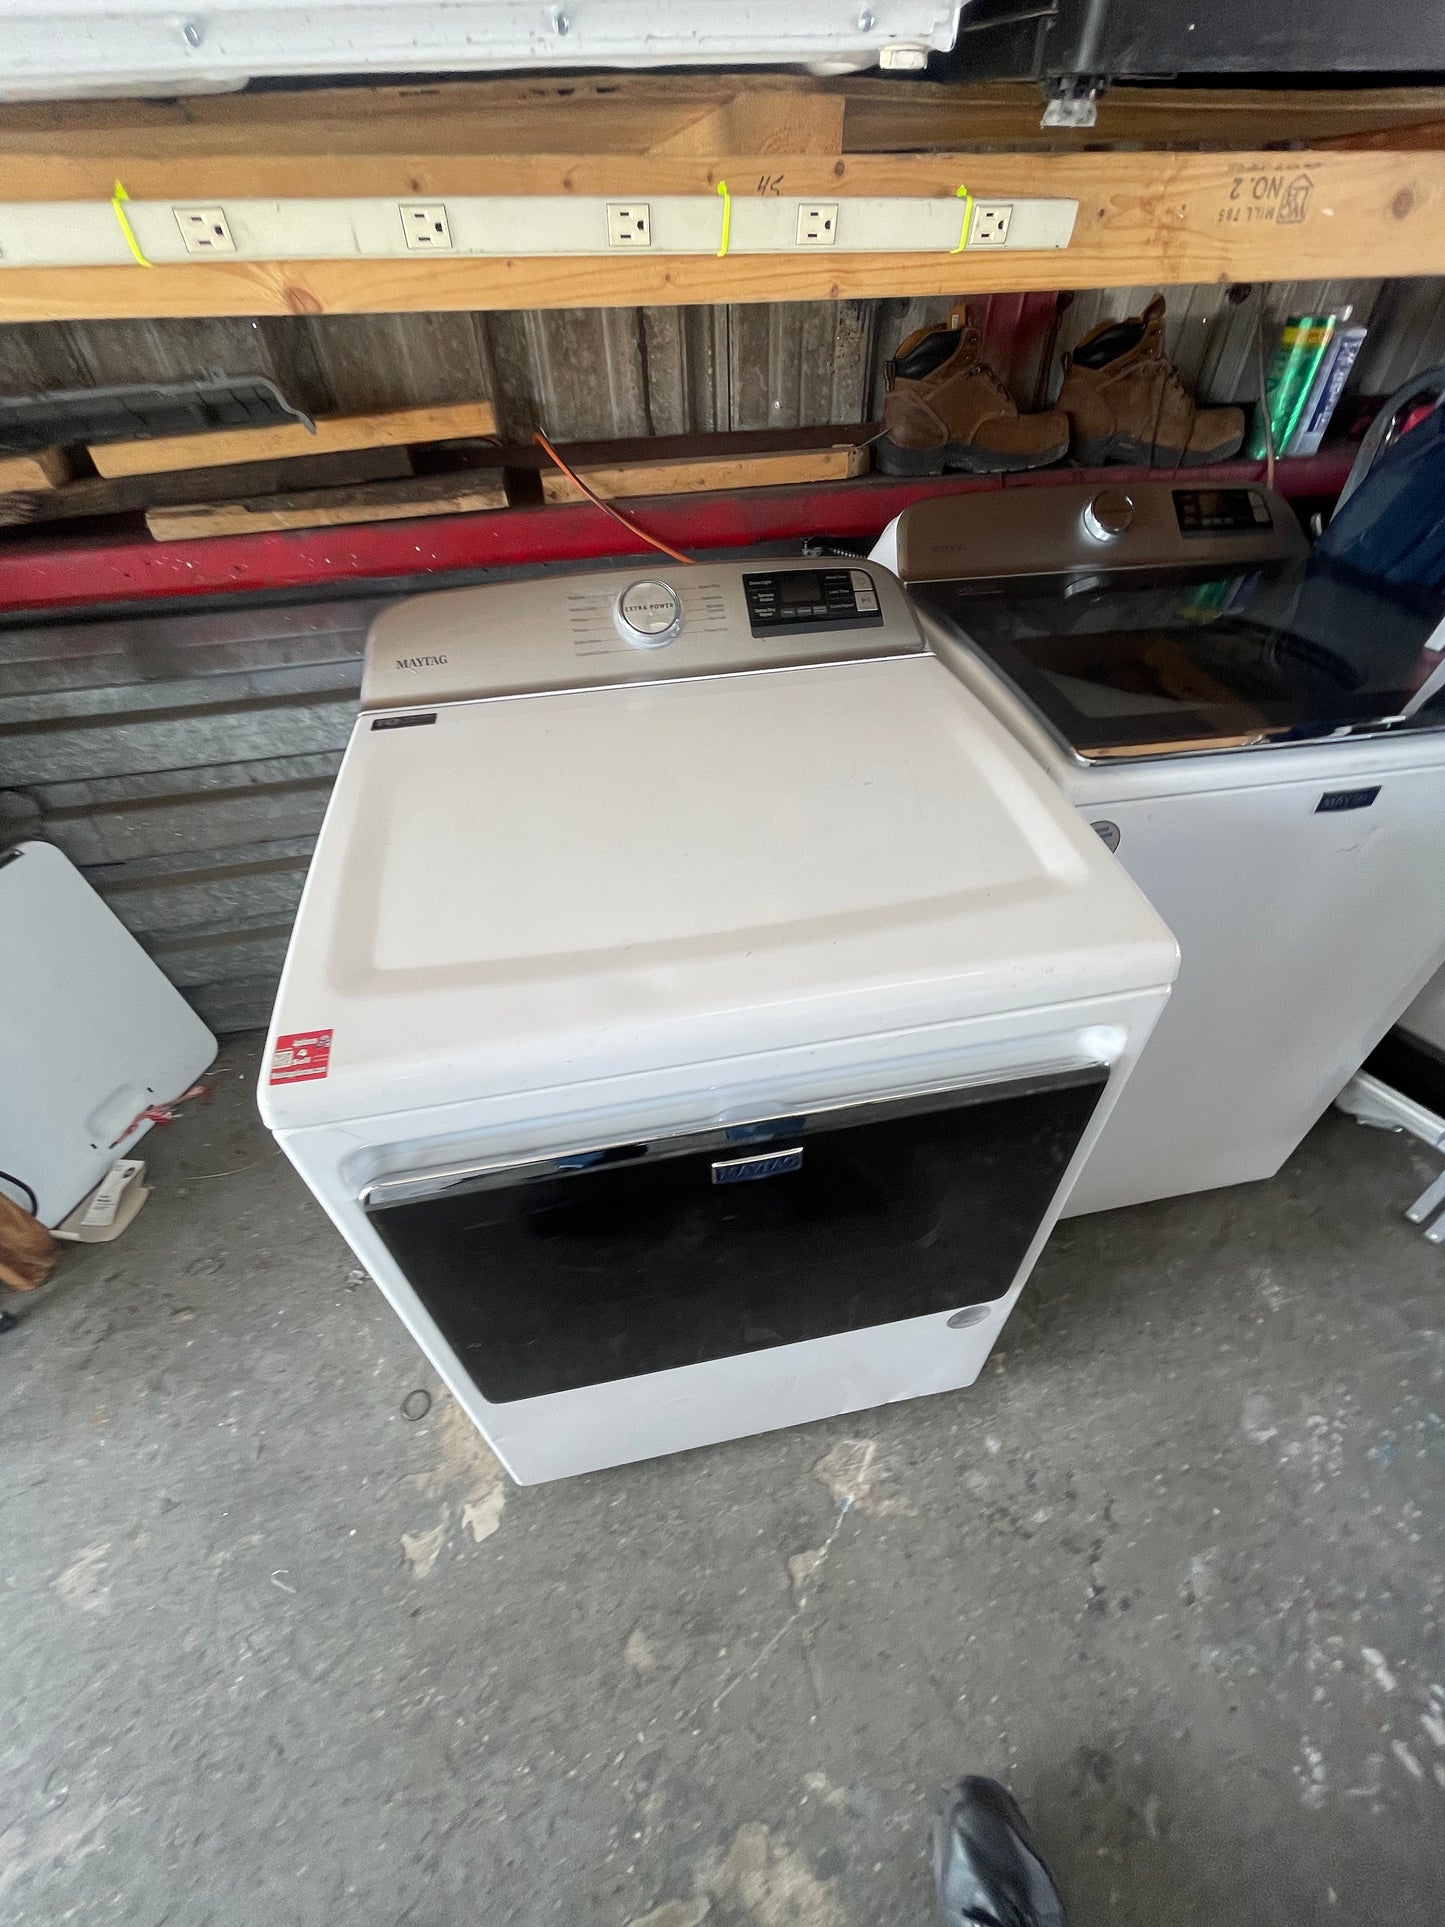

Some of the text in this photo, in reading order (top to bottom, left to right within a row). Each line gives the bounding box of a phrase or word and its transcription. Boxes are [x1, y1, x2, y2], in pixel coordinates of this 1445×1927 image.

[1230, 177, 1244, 200] 2
[1251, 175, 1283, 200] NO.
[1247, 206, 1276, 221] MILL
[649, 602, 674, 610] POWER
[396, 654, 448, 669] MAYTAG
